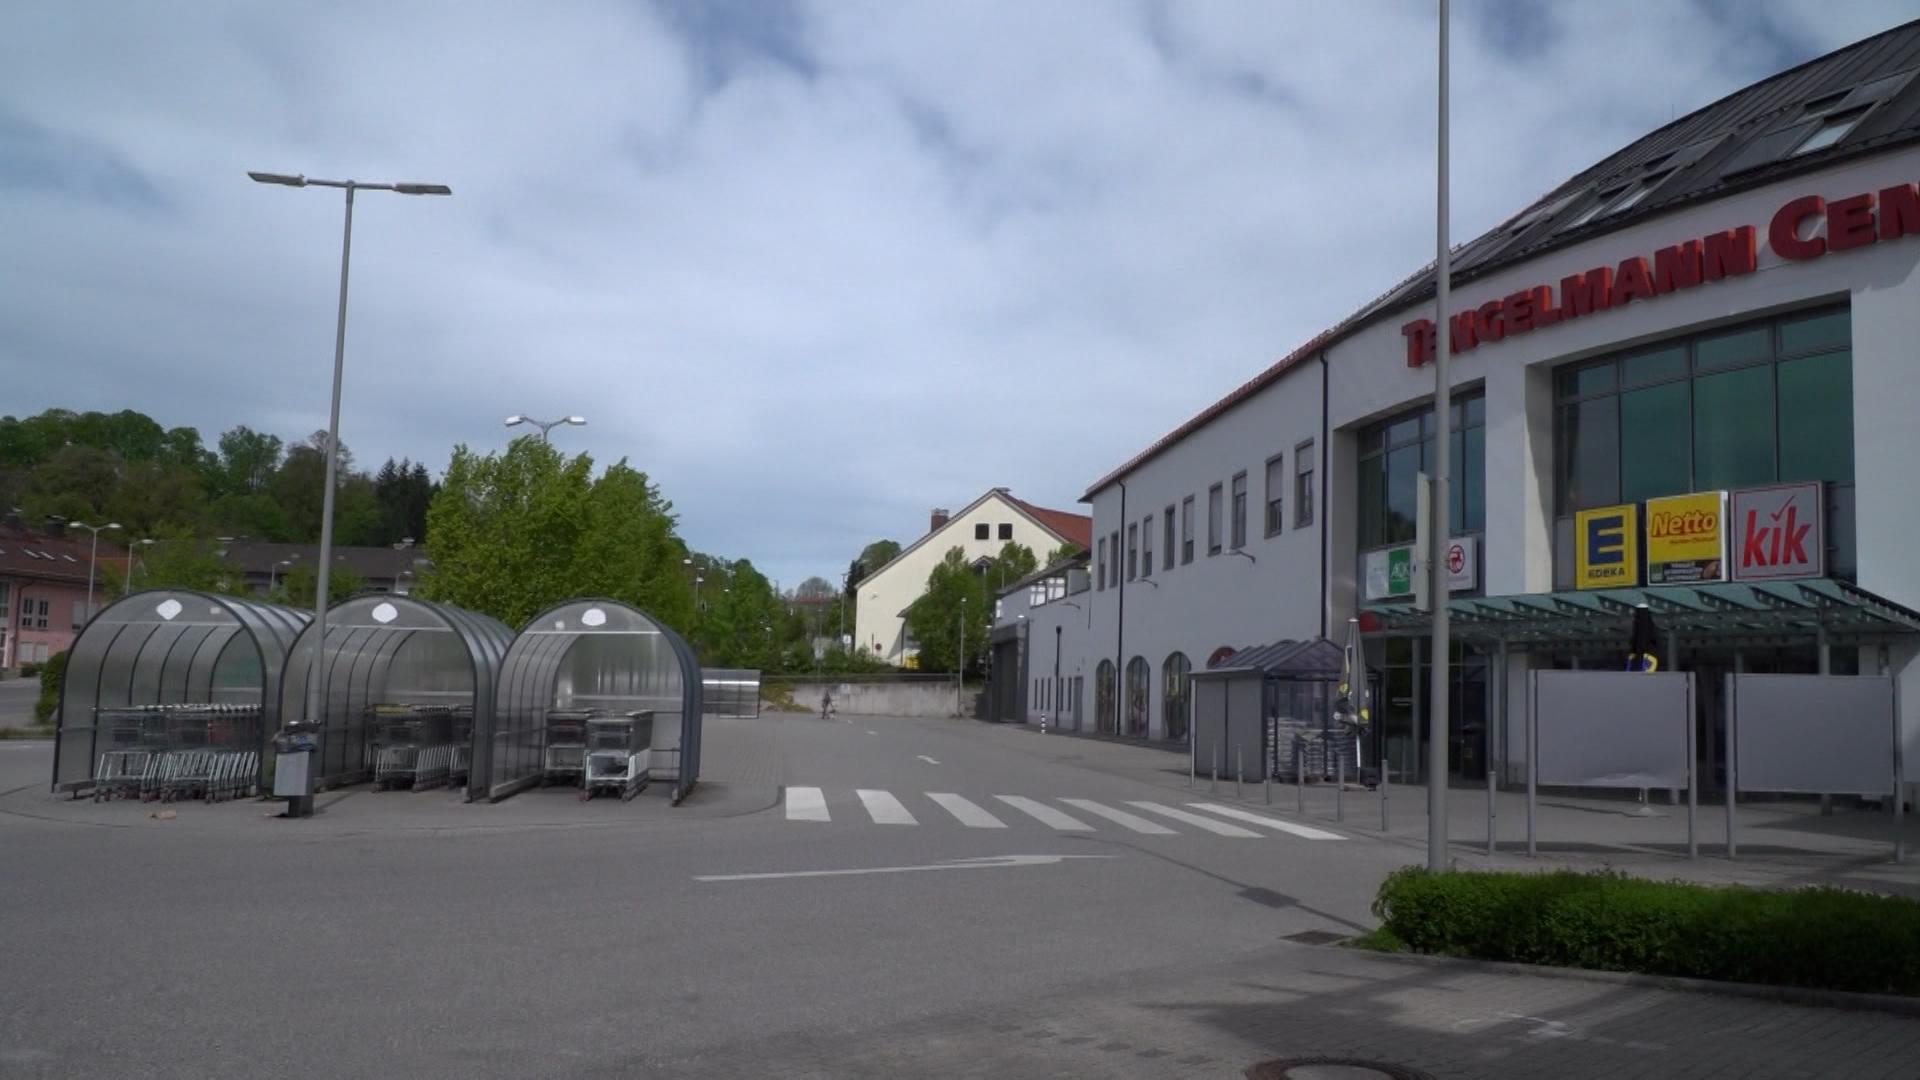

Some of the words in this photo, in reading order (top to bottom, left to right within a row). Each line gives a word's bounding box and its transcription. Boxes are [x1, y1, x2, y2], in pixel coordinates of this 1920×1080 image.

[1652, 510, 1717, 538] Netto
[1588, 515, 1624, 565] E
[1588, 567, 1626, 579] EDEKA
